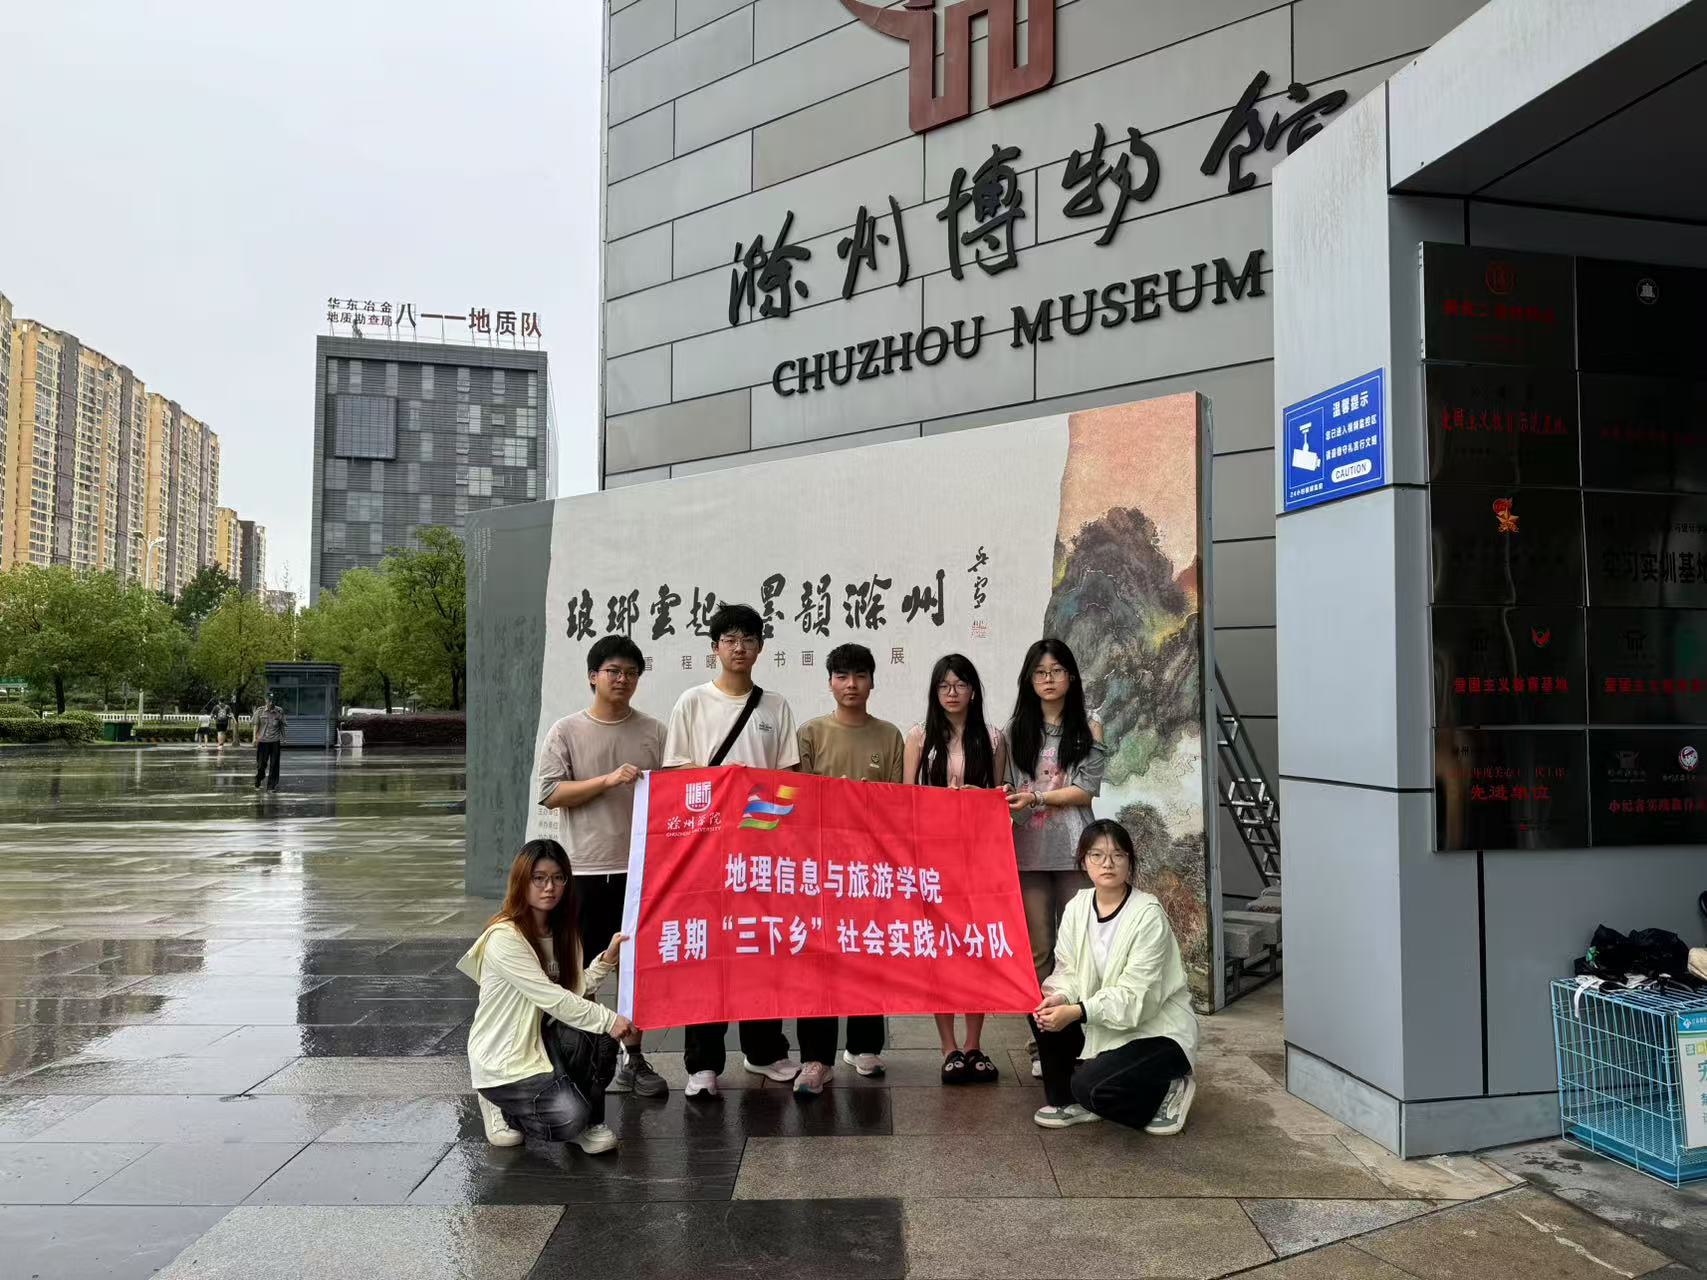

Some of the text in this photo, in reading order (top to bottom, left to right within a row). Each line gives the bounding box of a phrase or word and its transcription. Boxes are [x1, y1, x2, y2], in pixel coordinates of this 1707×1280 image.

[327, 297, 393, 314] 华东冶金
[395, 303, 542, 338] 八一一地质队
[772, 249, 1265, 397] CHUZHOU MUSEUM
[1335, 462, 1367, 480] CAUTION
[725, 852, 943, 904] 地理信息与旅游学院
